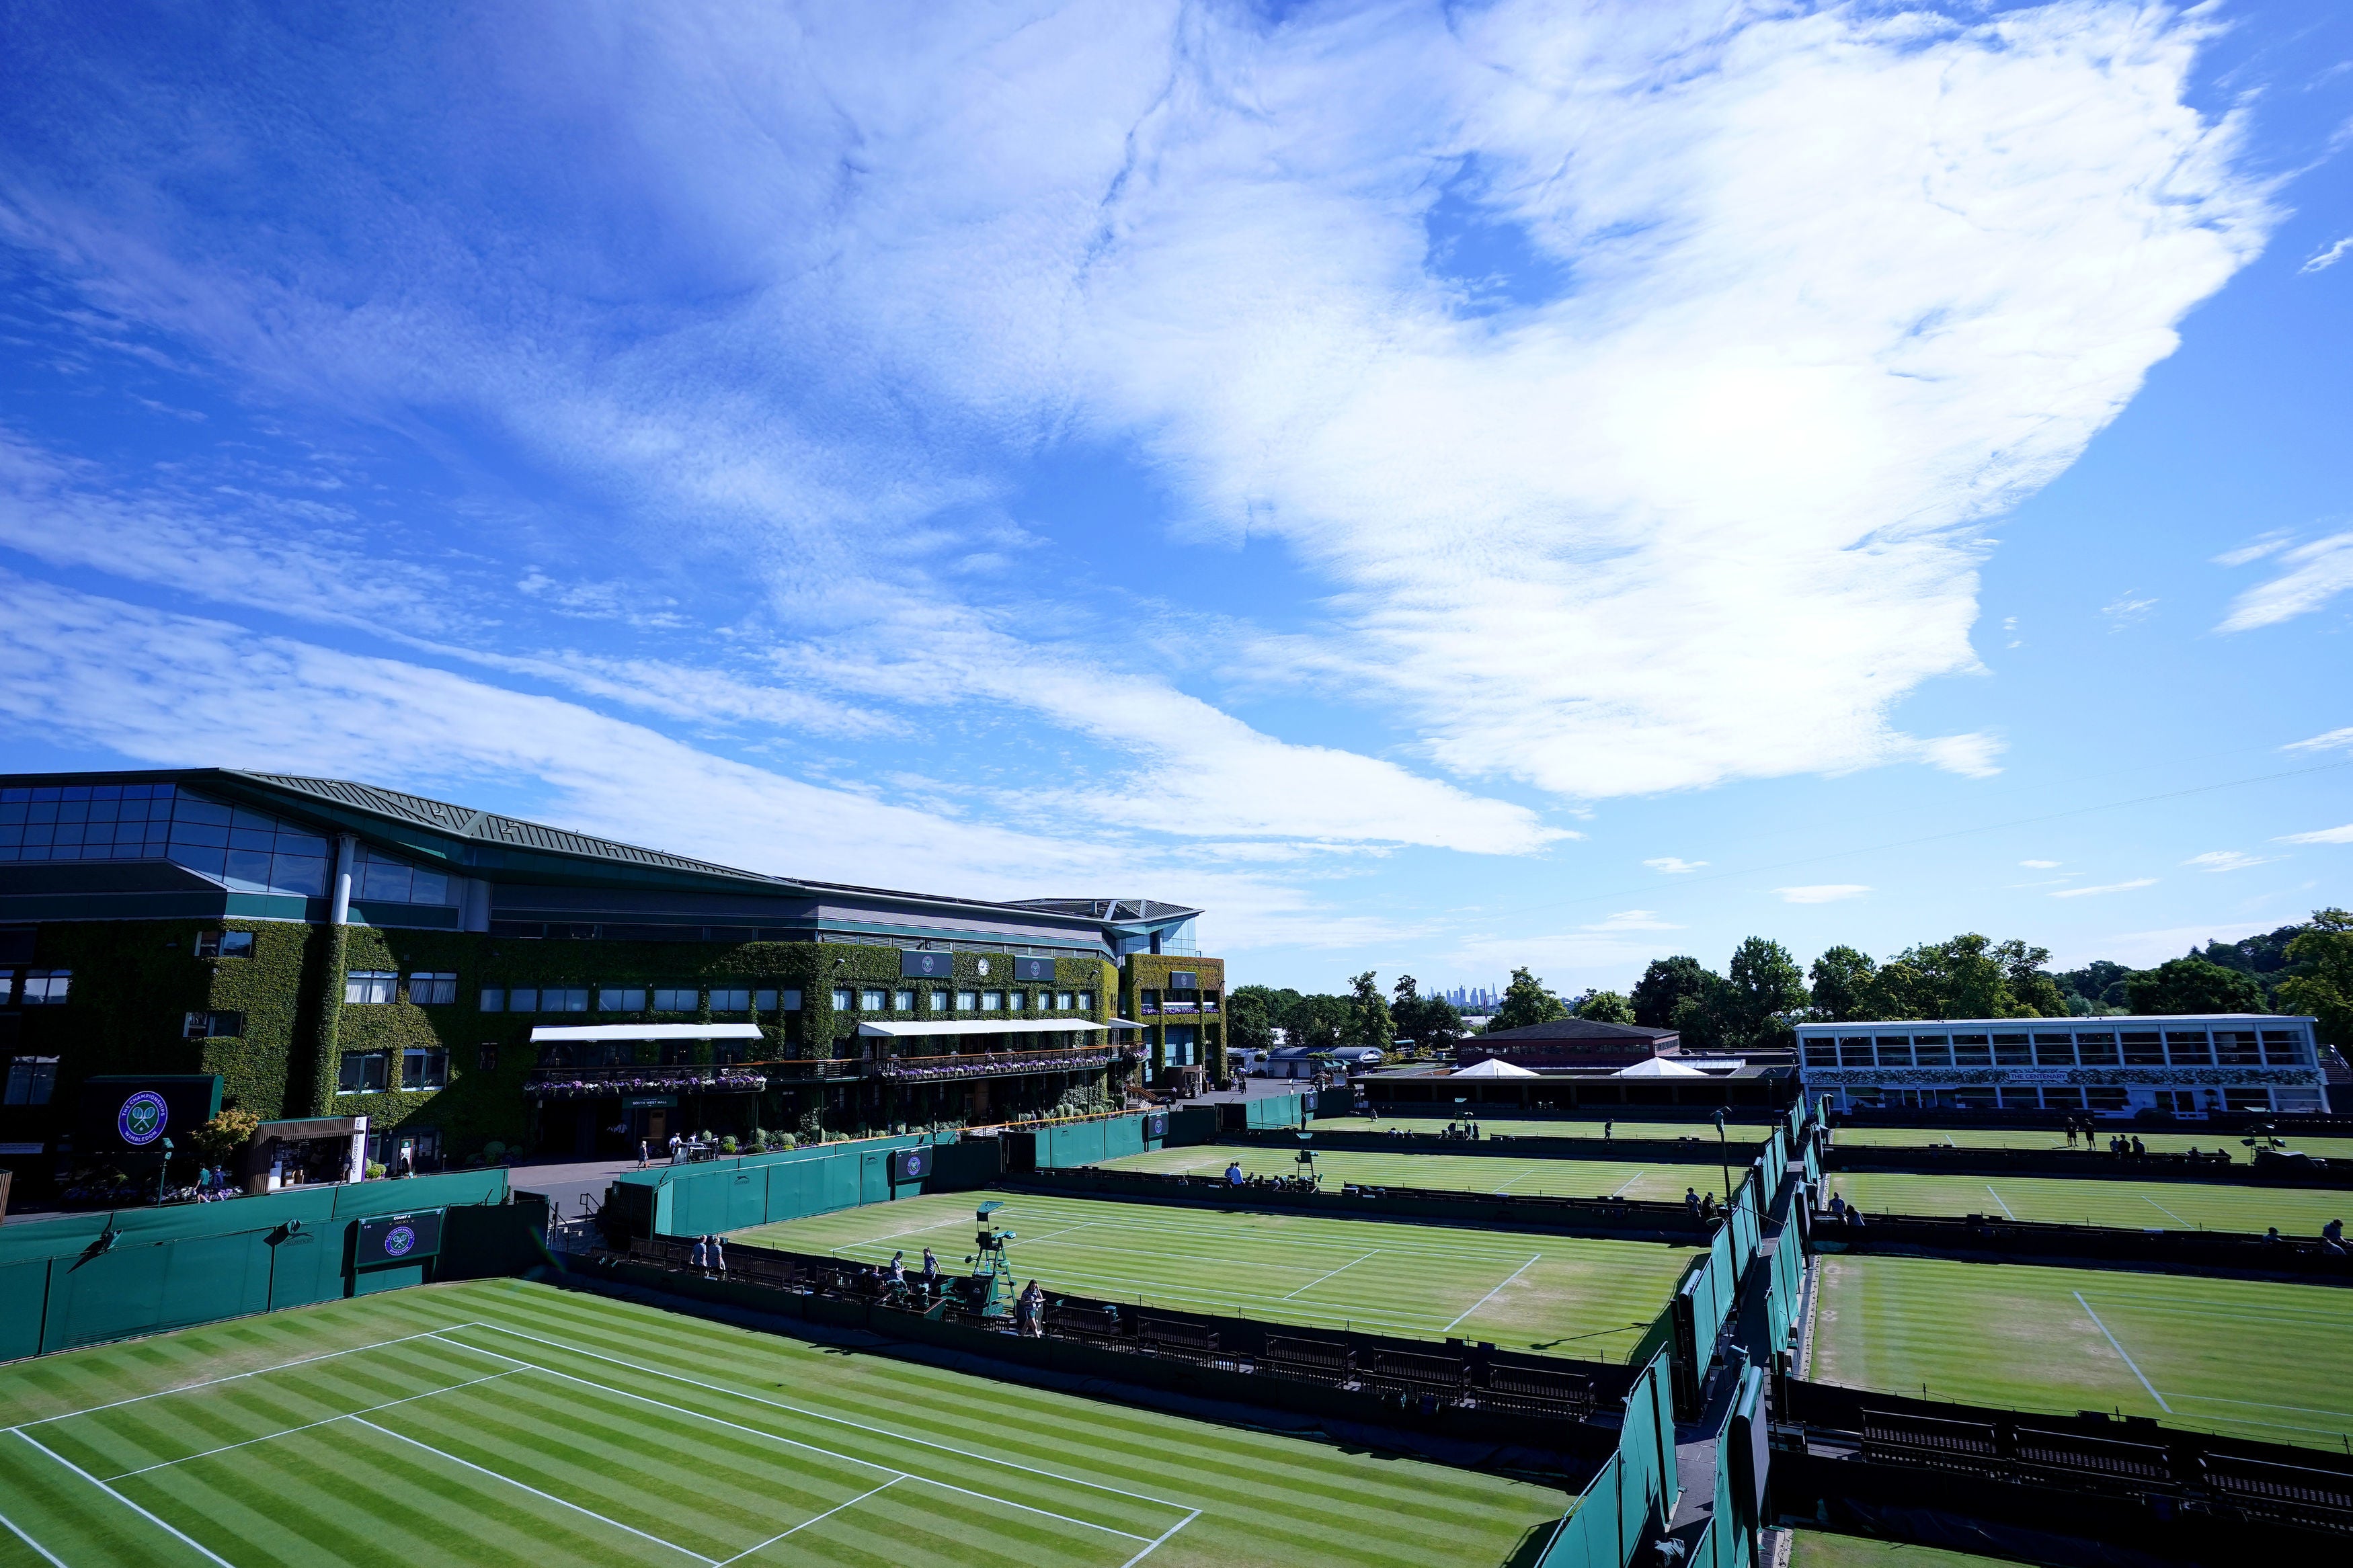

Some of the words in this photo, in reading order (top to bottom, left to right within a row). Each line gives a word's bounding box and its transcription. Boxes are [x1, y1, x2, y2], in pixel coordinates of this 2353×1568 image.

[122, 1104, 130, 1116] THE
[130, 1094, 165, 1116] CHAMPIONSHIPS
[125, 1130, 157, 1142] WIMBLEDON
